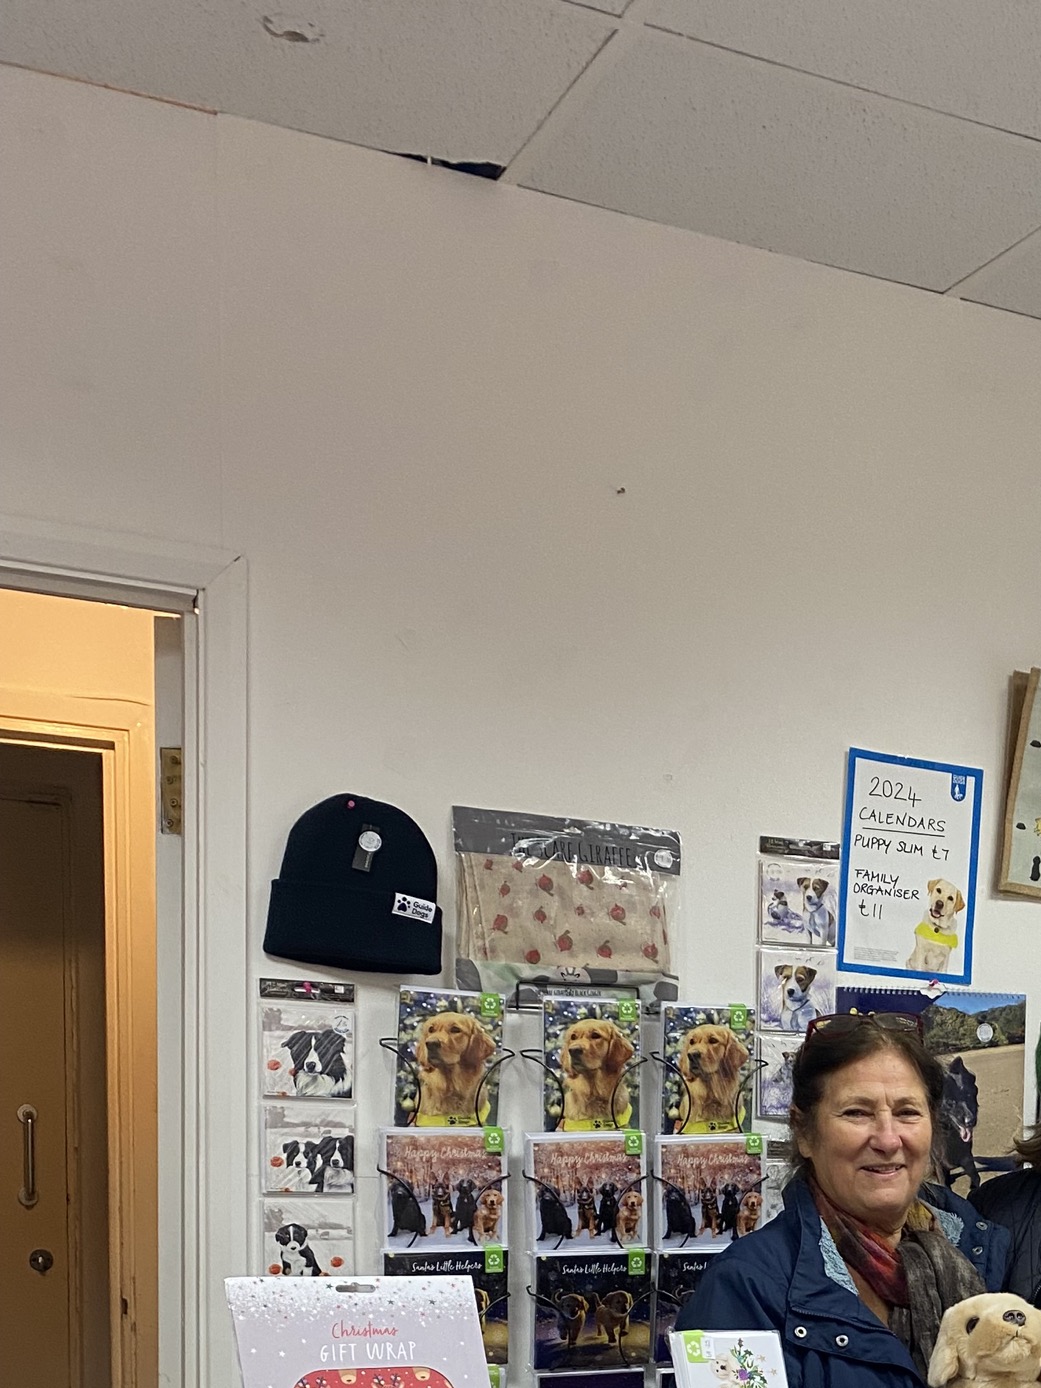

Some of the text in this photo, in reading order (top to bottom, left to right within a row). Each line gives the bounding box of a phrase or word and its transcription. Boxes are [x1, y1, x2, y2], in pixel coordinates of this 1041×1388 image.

[868, 776, 922, 808] 2024
[859, 806, 946, 832] CALENDARS
[854, 833, 950, 862] PUPPY SLIM £7
[854, 868, 900, 889] FAMILY
[853, 883, 920, 900] ORGANISER
[411, 908, 430, 919] Dogs
[413, 901, 433, 913] Guide
[858, 899, 883, 920] £11
[404, 1147, 439, 1168] Happy
[551, 1151, 628, 1168] Happy Christmas
[677, 1153, 748, 1168] Happy Christmas
[436, 1259, 455, 1271] Little
[456, 1259, 483, 1272] Helpers
[584, 1263, 602, 1274] Little
[603, 1263, 628, 1276] Helpers
[331, 1320, 399, 1340] Christmas
[320, 1341, 417, 1363] GIFT WRAP
